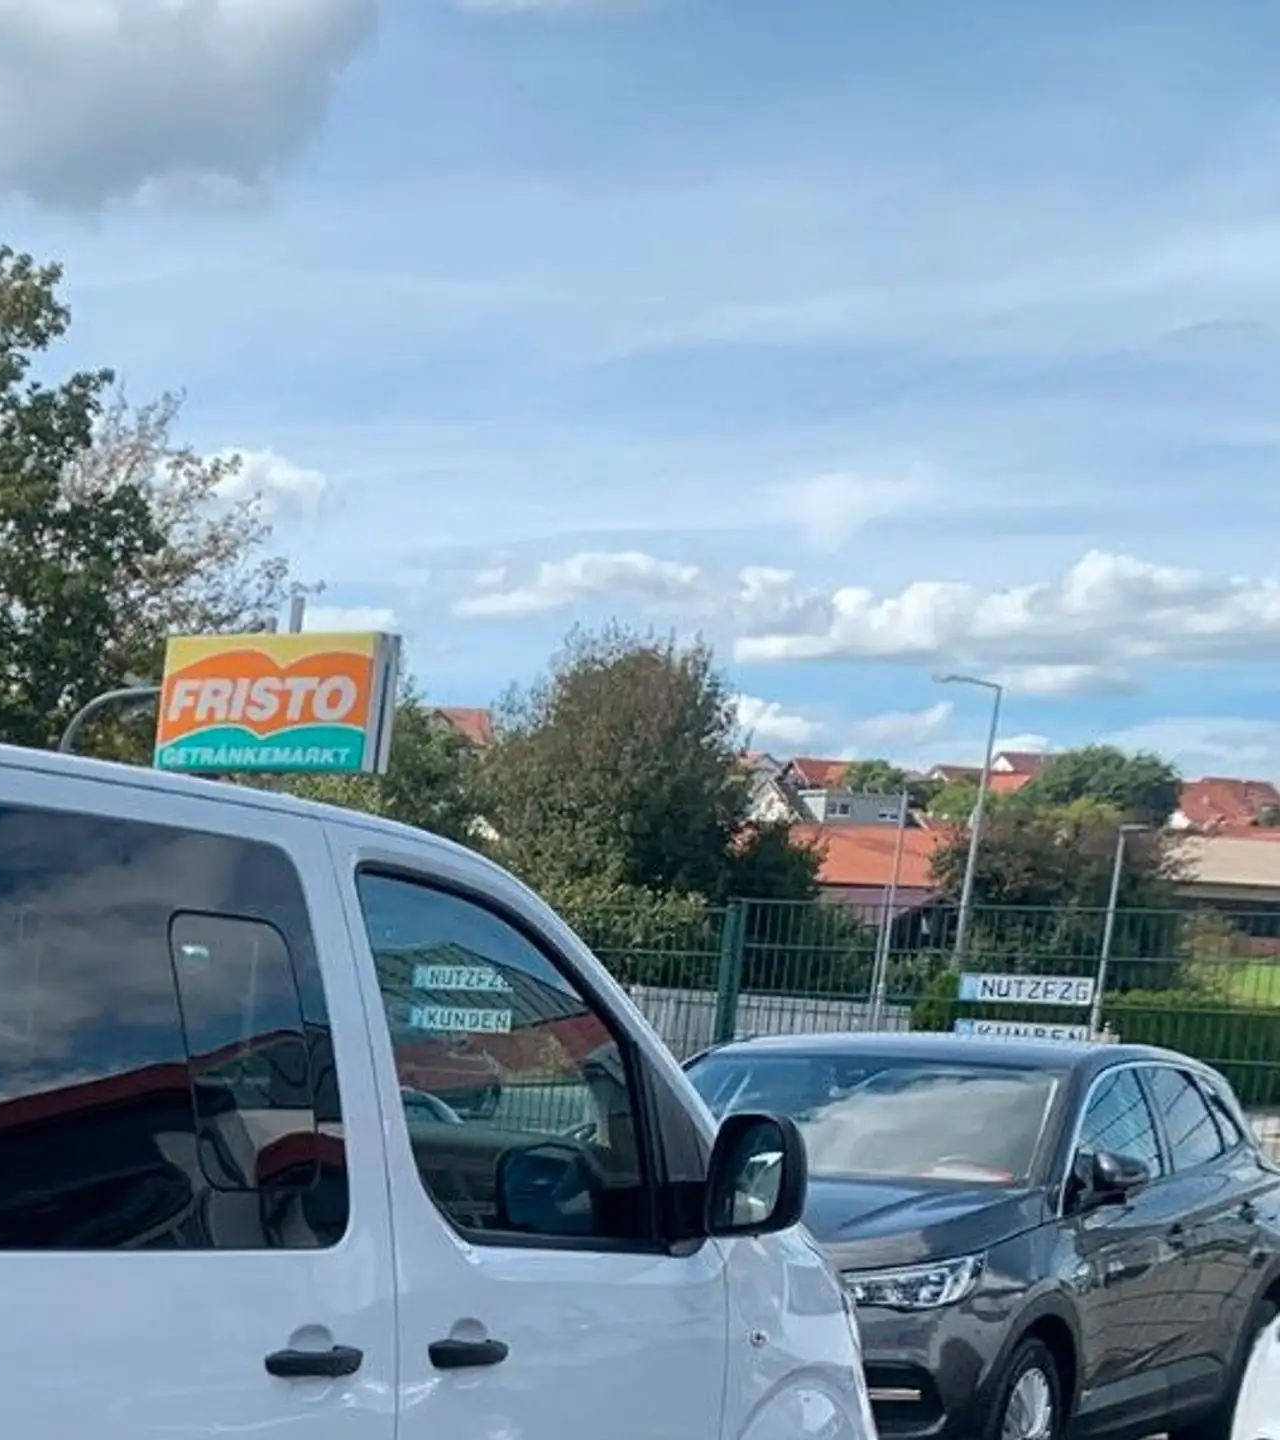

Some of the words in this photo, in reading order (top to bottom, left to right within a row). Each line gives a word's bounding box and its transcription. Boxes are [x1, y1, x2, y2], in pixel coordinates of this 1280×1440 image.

[165, 675, 358, 723] FRISTO
[161, 745, 352, 768] GETRÄNKEMARKT
[980, 978, 1090, 1002] NUTZFZG
[427, 1009, 507, 1030] KUNDEN
